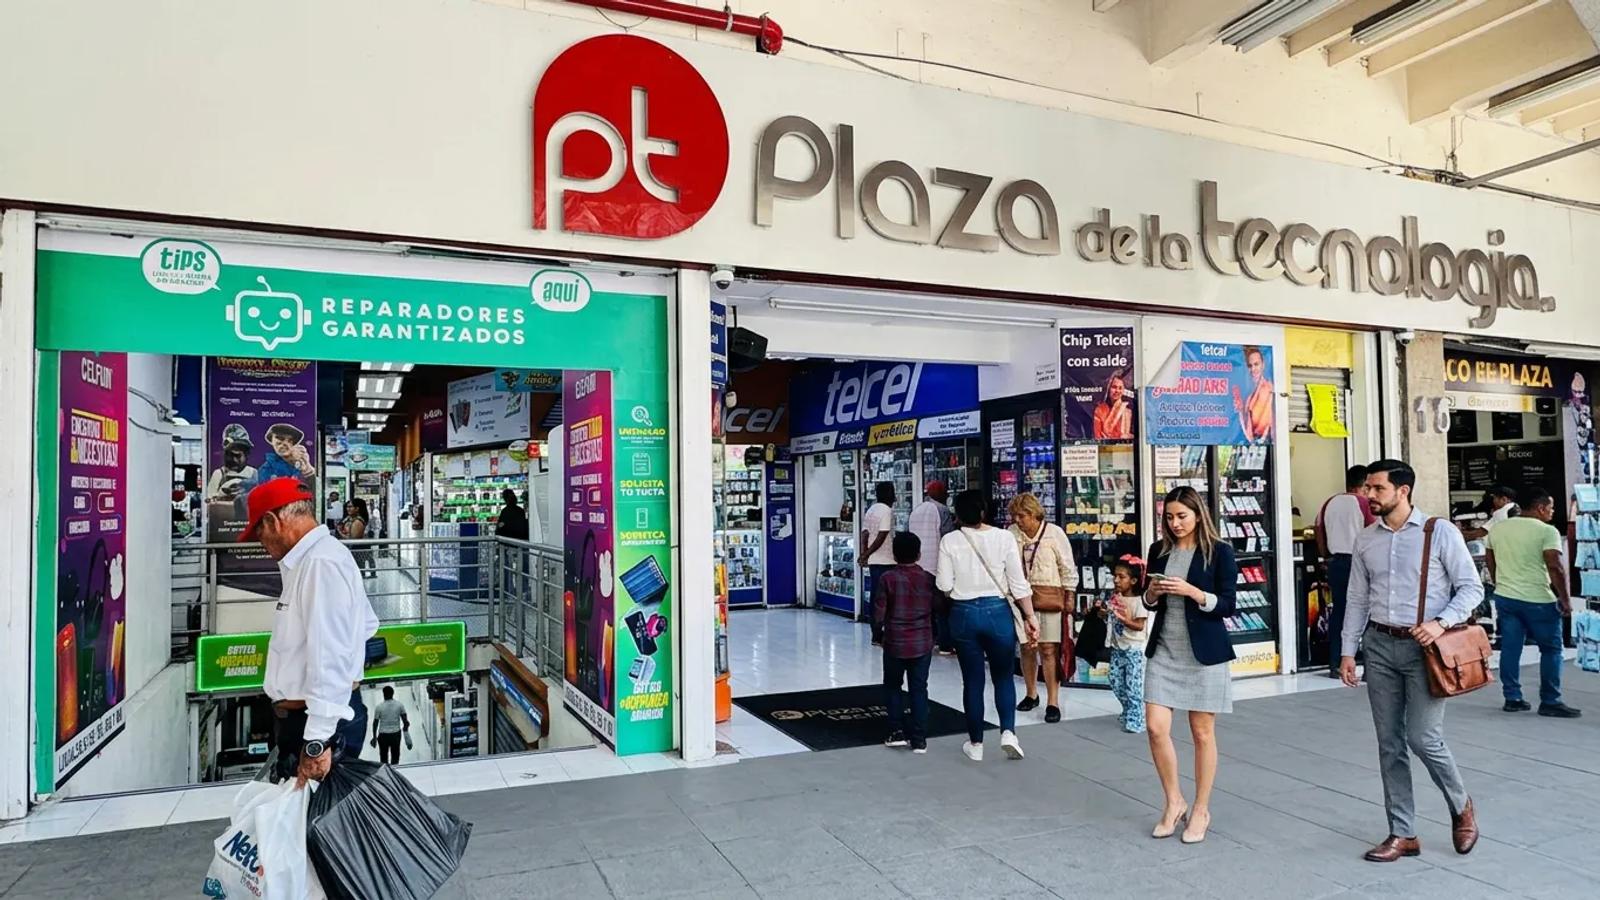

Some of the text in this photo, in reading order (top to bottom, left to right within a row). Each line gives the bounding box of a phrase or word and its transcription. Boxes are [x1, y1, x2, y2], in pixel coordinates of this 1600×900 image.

[545, 86, 680, 231] pt
[755, 115, 1061, 256] Plaza
[1076, 208, 1139, 265] de
[1143, 214, 1194, 270] la
[160, 247, 206, 272] tips
[322, 297, 525, 324] REPARADORES
[322, 320, 525, 345] GARANTIZADOS
[1062, 333, 1132, 350] Chip Telcel
[1067, 354, 1128, 367] con salde
[1444, 359, 1471, 383] CO
[1499, 363, 1553, 388] PLAZA
[823, 362, 924, 426] telcel
